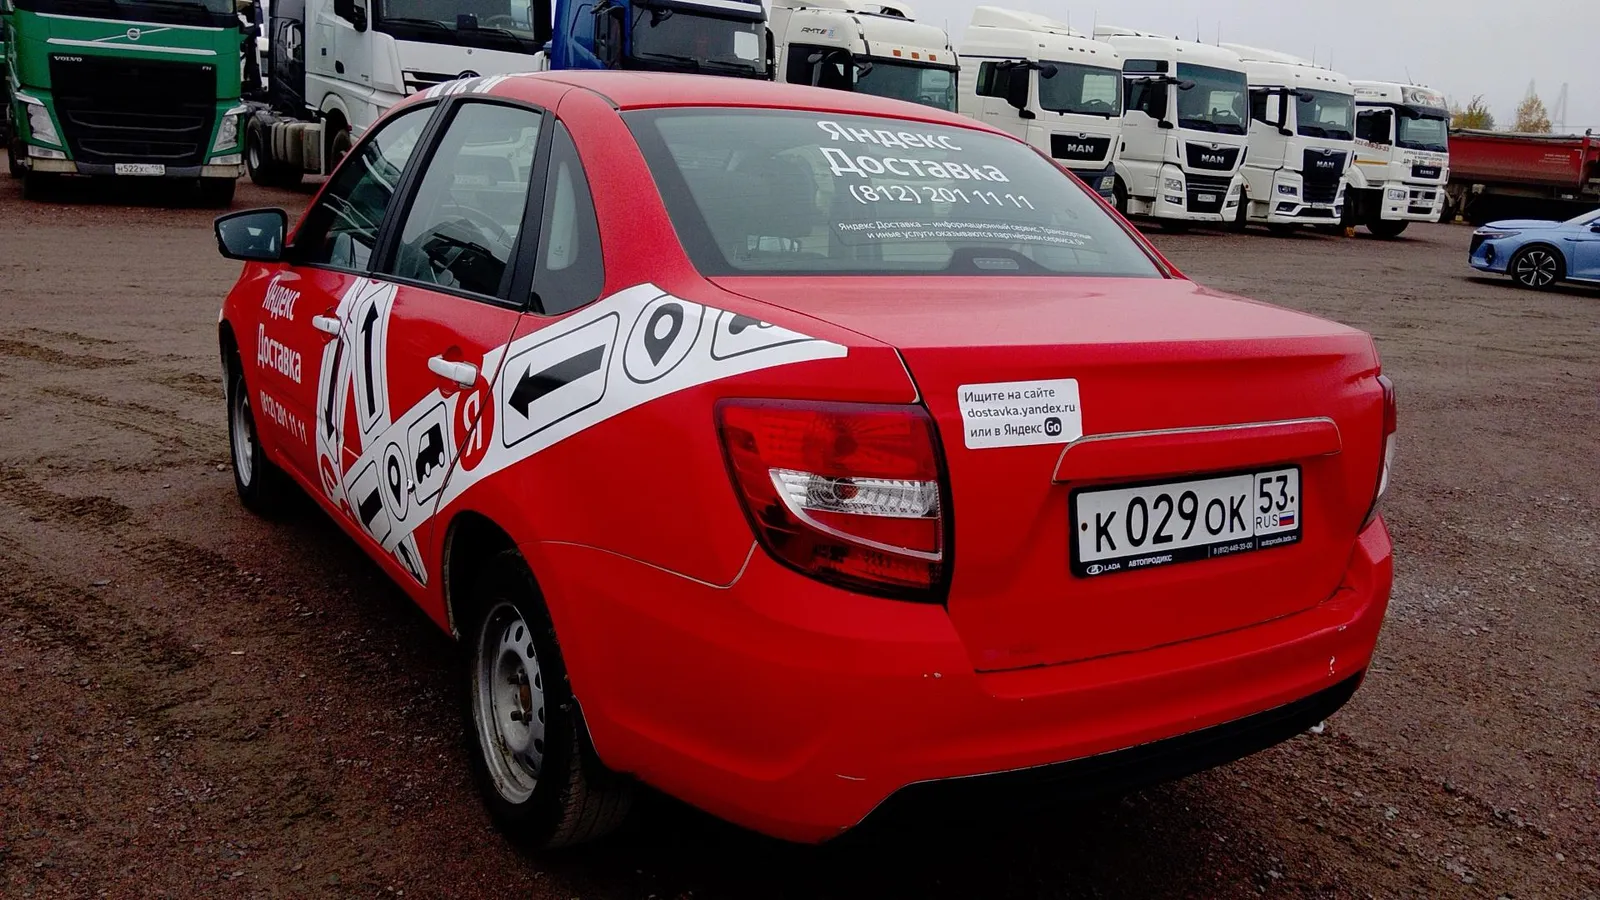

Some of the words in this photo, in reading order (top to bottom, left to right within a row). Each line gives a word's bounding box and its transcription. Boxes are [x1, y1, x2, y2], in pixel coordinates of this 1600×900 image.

[817, 120, 963, 150] Яндекс
[1067, 143, 1094, 153] MAN
[819, 147, 1010, 182] Доставка
[1201, 153, 1225, 164] MAN
[1316, 160, 1335, 169] MAN
[850, 184, 922, 204] (812)
[922, 186, 971, 204] 201
[973, 190, 1004, 206] 11
[1005, 193, 1035, 210] 11
[838, 222, 875, 231] Яндекс
[875, 221, 921, 229] Доставка
[932, 221, 1010, 230] информационный
[901, 231, 935, 239] услуги
[262, 274, 300, 321] Яндекс
[258, 322, 301, 384] Доставка
[964, 391, 1005, 403] Ищите
[1007, 391, 1021, 400] на
[1024, 387, 1055, 399] сайте
[260, 389, 278, 424] (812)
[276, 401, 288, 430] 201
[289, 412, 298, 437] 11
[298, 420, 307, 446] 11
[967, 403, 1075, 418] dostavka.yandex.ru
[970, 428, 992, 437] или
[994, 428, 1001, 436] в
[1004, 423, 1042, 437] Яндекс
[1046, 420, 1060, 433] Go
[1259, 474, 1289, 514] 53
[1256, 514, 1279, 530] RUS
[1217, 545, 1230, 555] (812)
[1104, 563, 1121, 571] LADA
[1128, 555, 1173, 567] АВТОПРОДИКС
